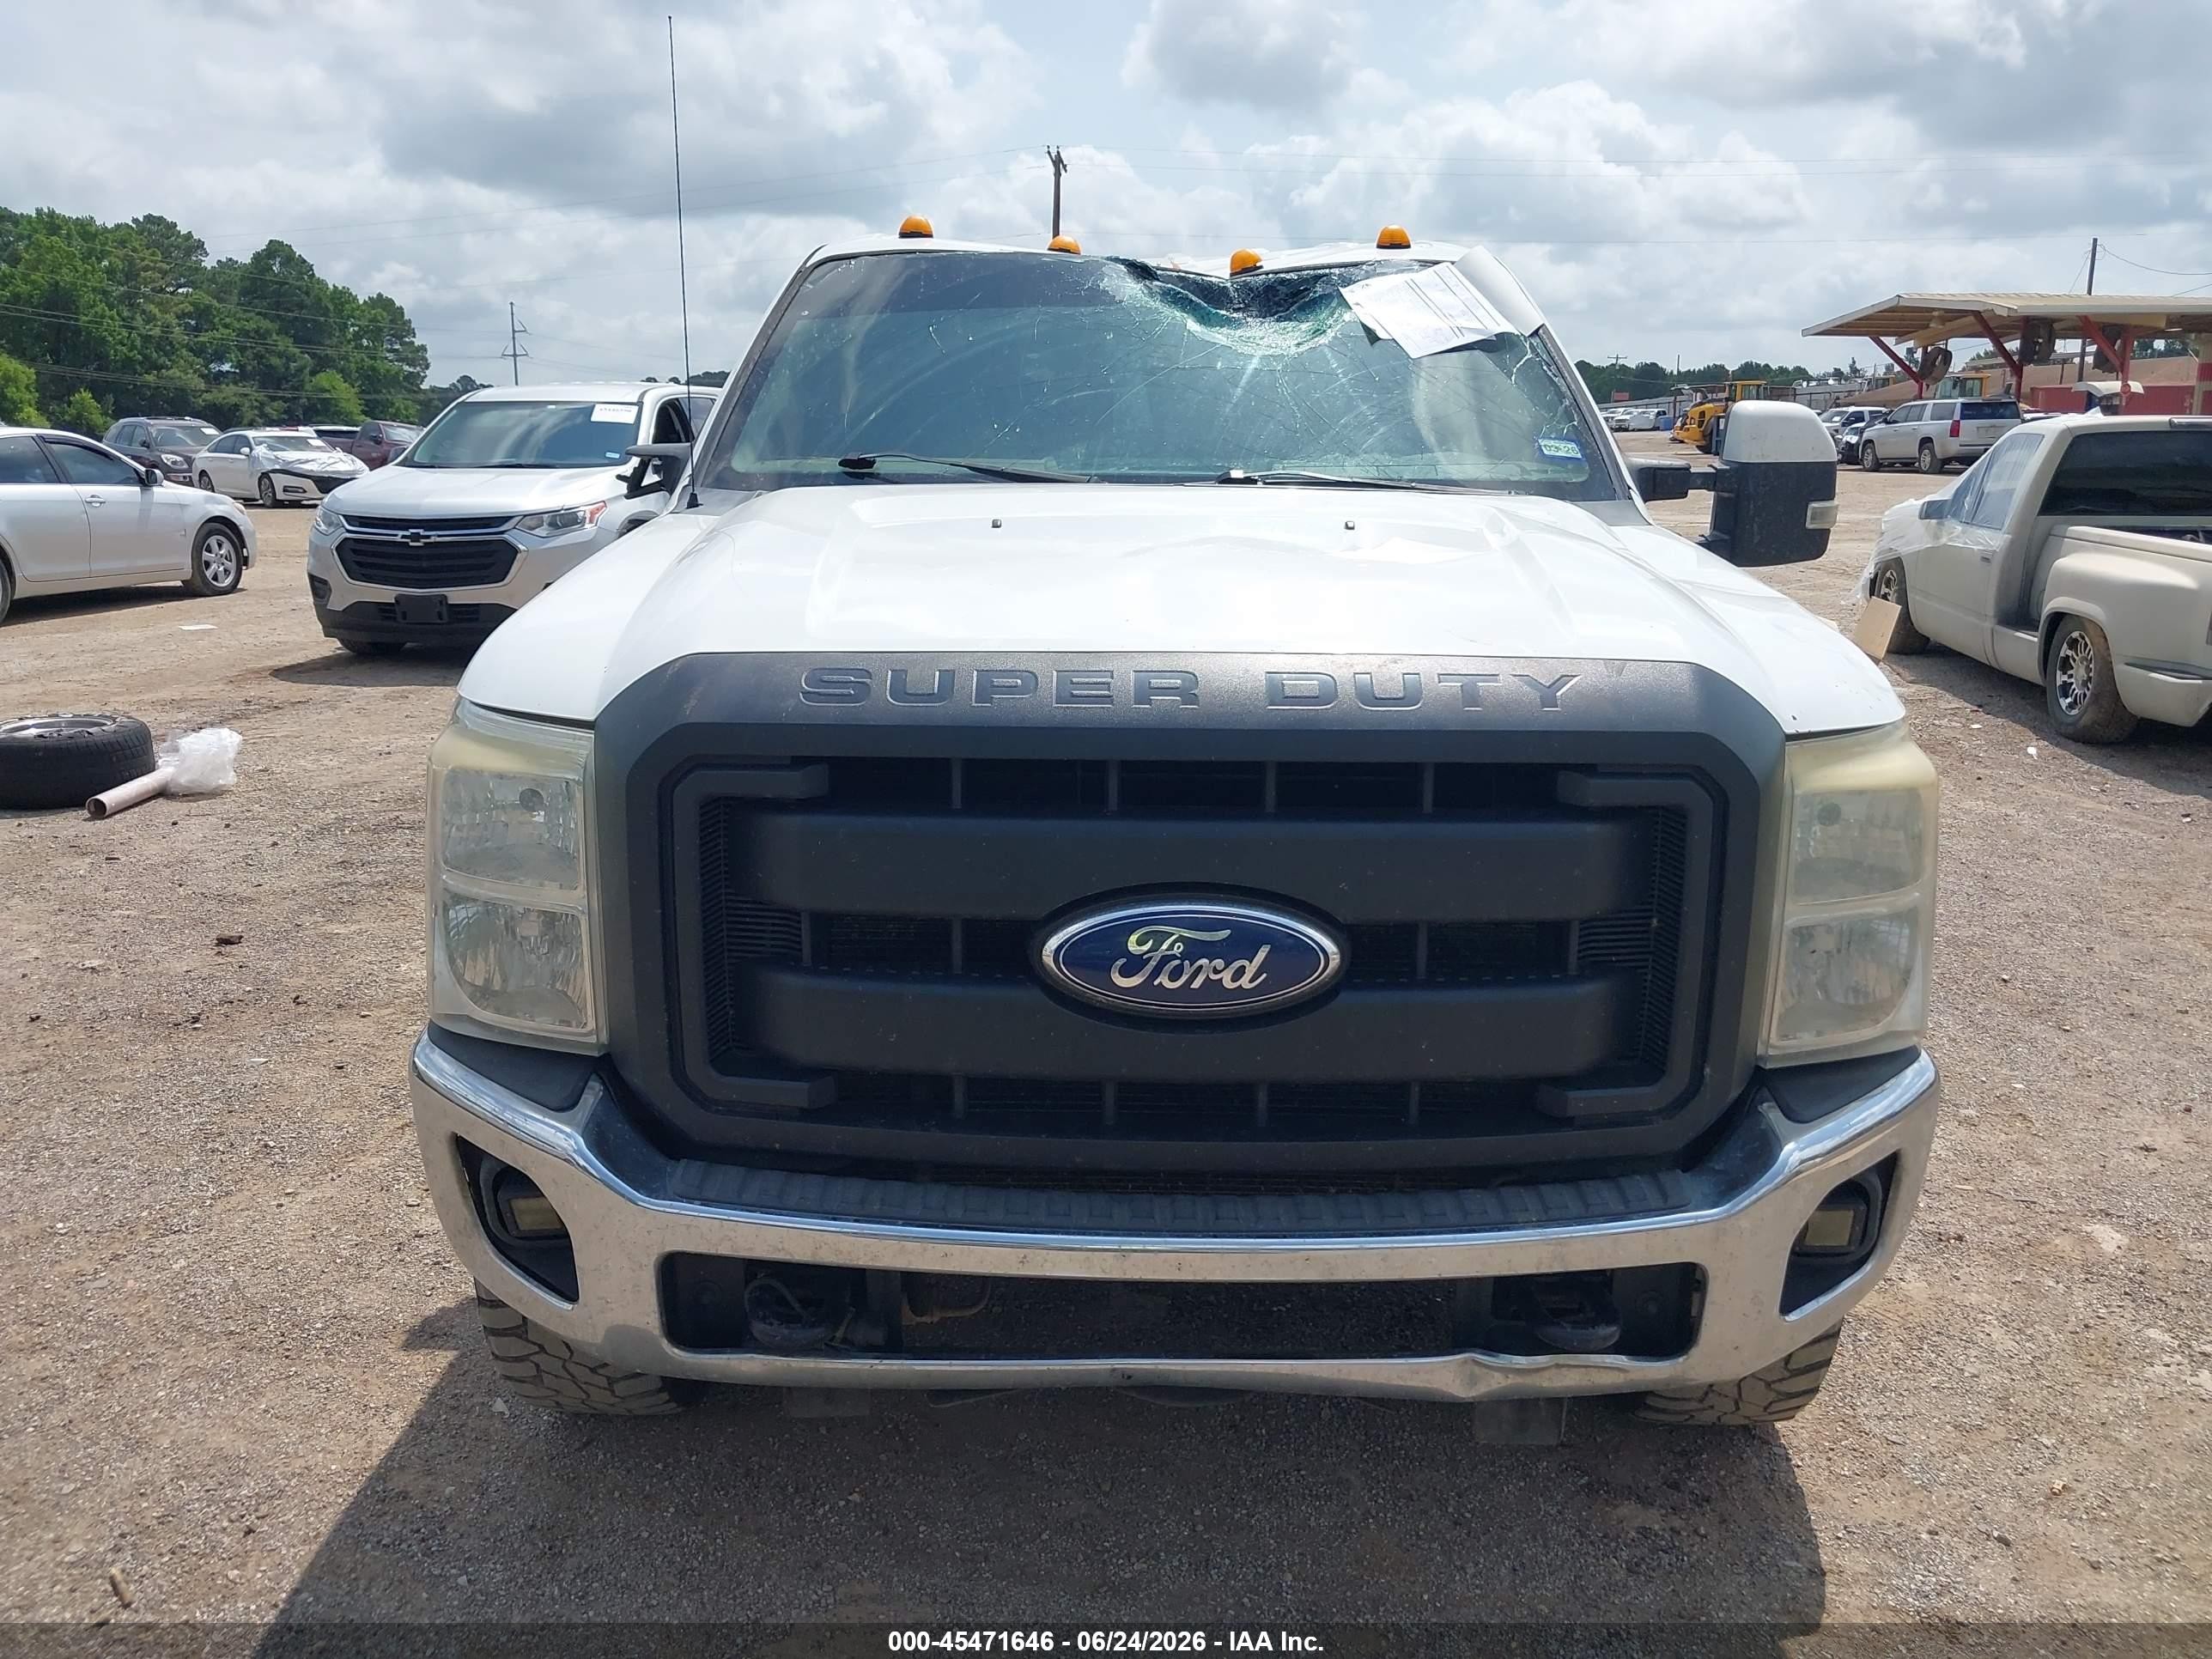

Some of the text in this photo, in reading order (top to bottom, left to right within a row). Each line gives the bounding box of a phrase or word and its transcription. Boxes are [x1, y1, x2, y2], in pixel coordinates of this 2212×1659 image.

[799, 667, 1583, 712] SUPER DUTY
[1110, 925, 1272, 989] Ford
